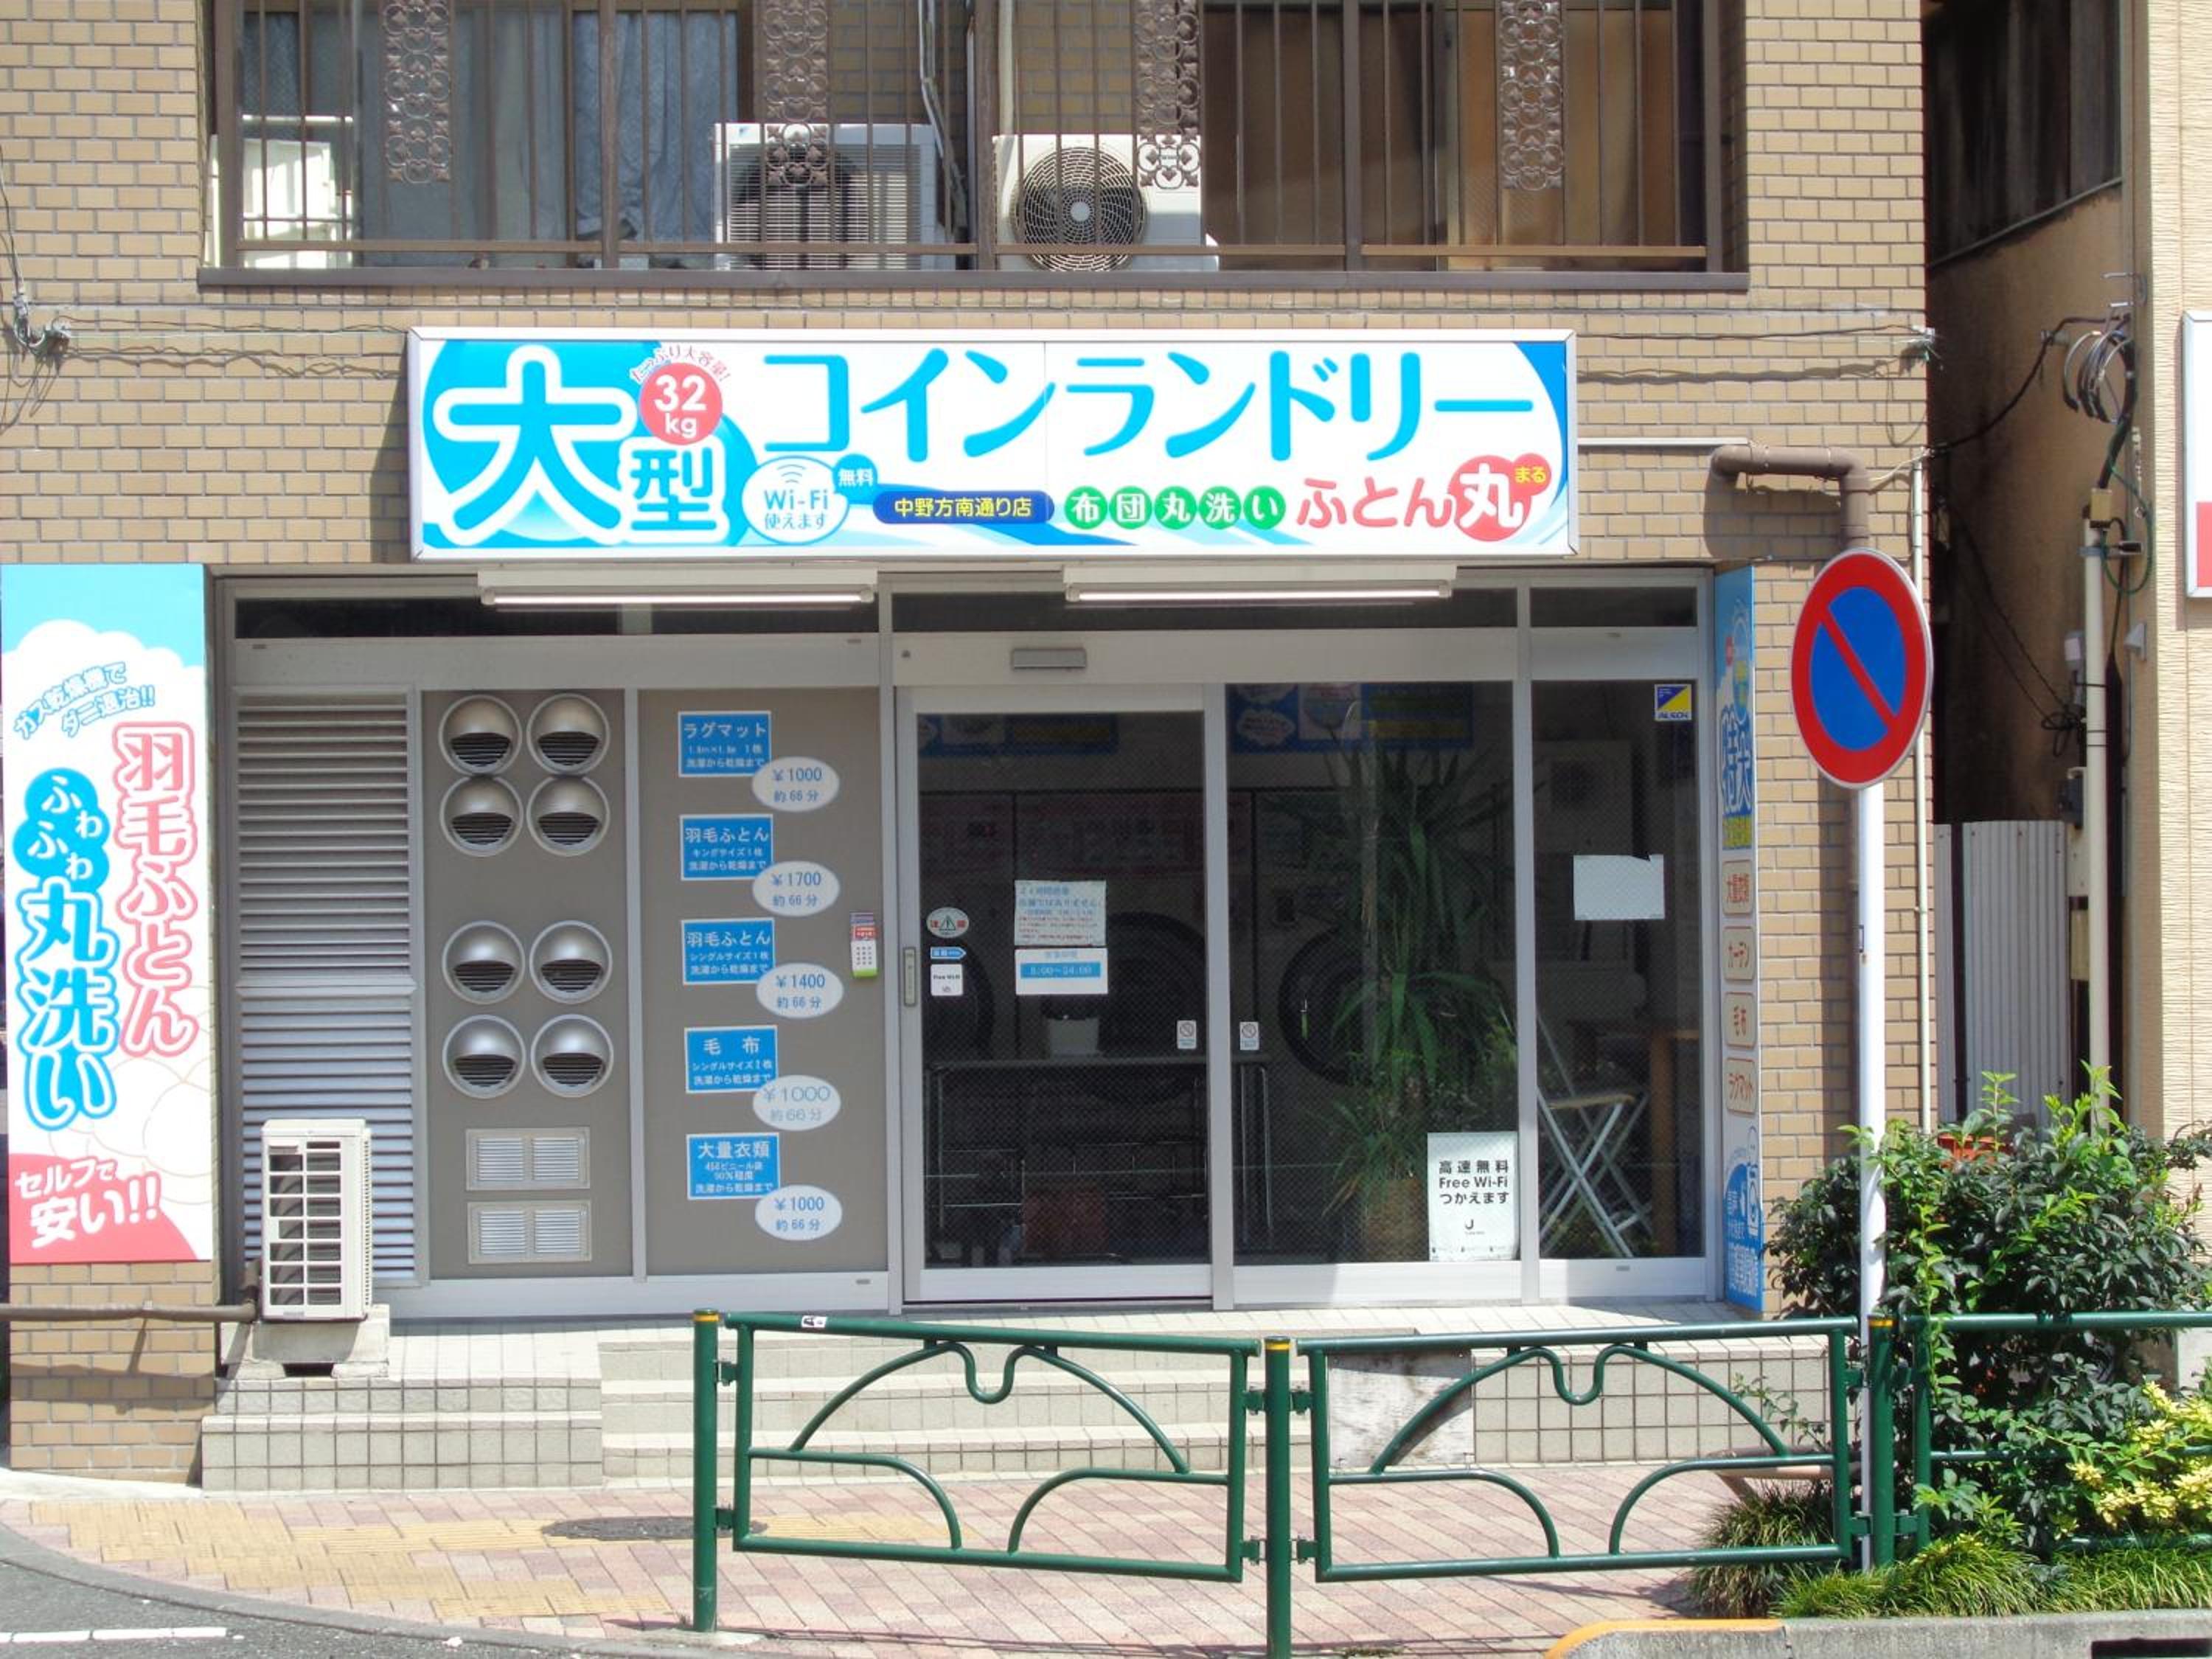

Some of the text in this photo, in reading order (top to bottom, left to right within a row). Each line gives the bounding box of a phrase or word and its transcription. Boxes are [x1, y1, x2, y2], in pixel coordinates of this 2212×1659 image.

[654, 374, 707, 413] 32
[763, 347, 1534, 462] コインランドリー
[664, 412, 697, 439] kg
[442, 355, 719, 535] 大型
[838, 467, 874, 487] 無料
[1514, 465, 1548, 484] まる
[763, 489, 829, 510] Wi-Fi
[894, 497, 1032, 518] 中野方南通り店
[1069, 488, 1281, 526] 布団丸洗い
[764, 512, 826, 531] 使えます
[13, 661, 128, 740] ガス乾燥機で
[684, 722, 767, 738] ラグマット
[684, 827, 769, 844] 羽毛ふとん
[112, 720, 199, 1058] 羽毛ふとん
[686, 931, 771, 947] 羽毛ふとん
[15, 875, 120, 1132] 丸洗い
[698, 1141, 771, 1159] 大量衣類
[15, 1158, 118, 1200] セルフで
[1439, 1176, 1509, 1189] Free Wi-Fi
[1439, 1192, 1509, 1205] つかえます
[30, 1174, 159, 1250] 安い!!
